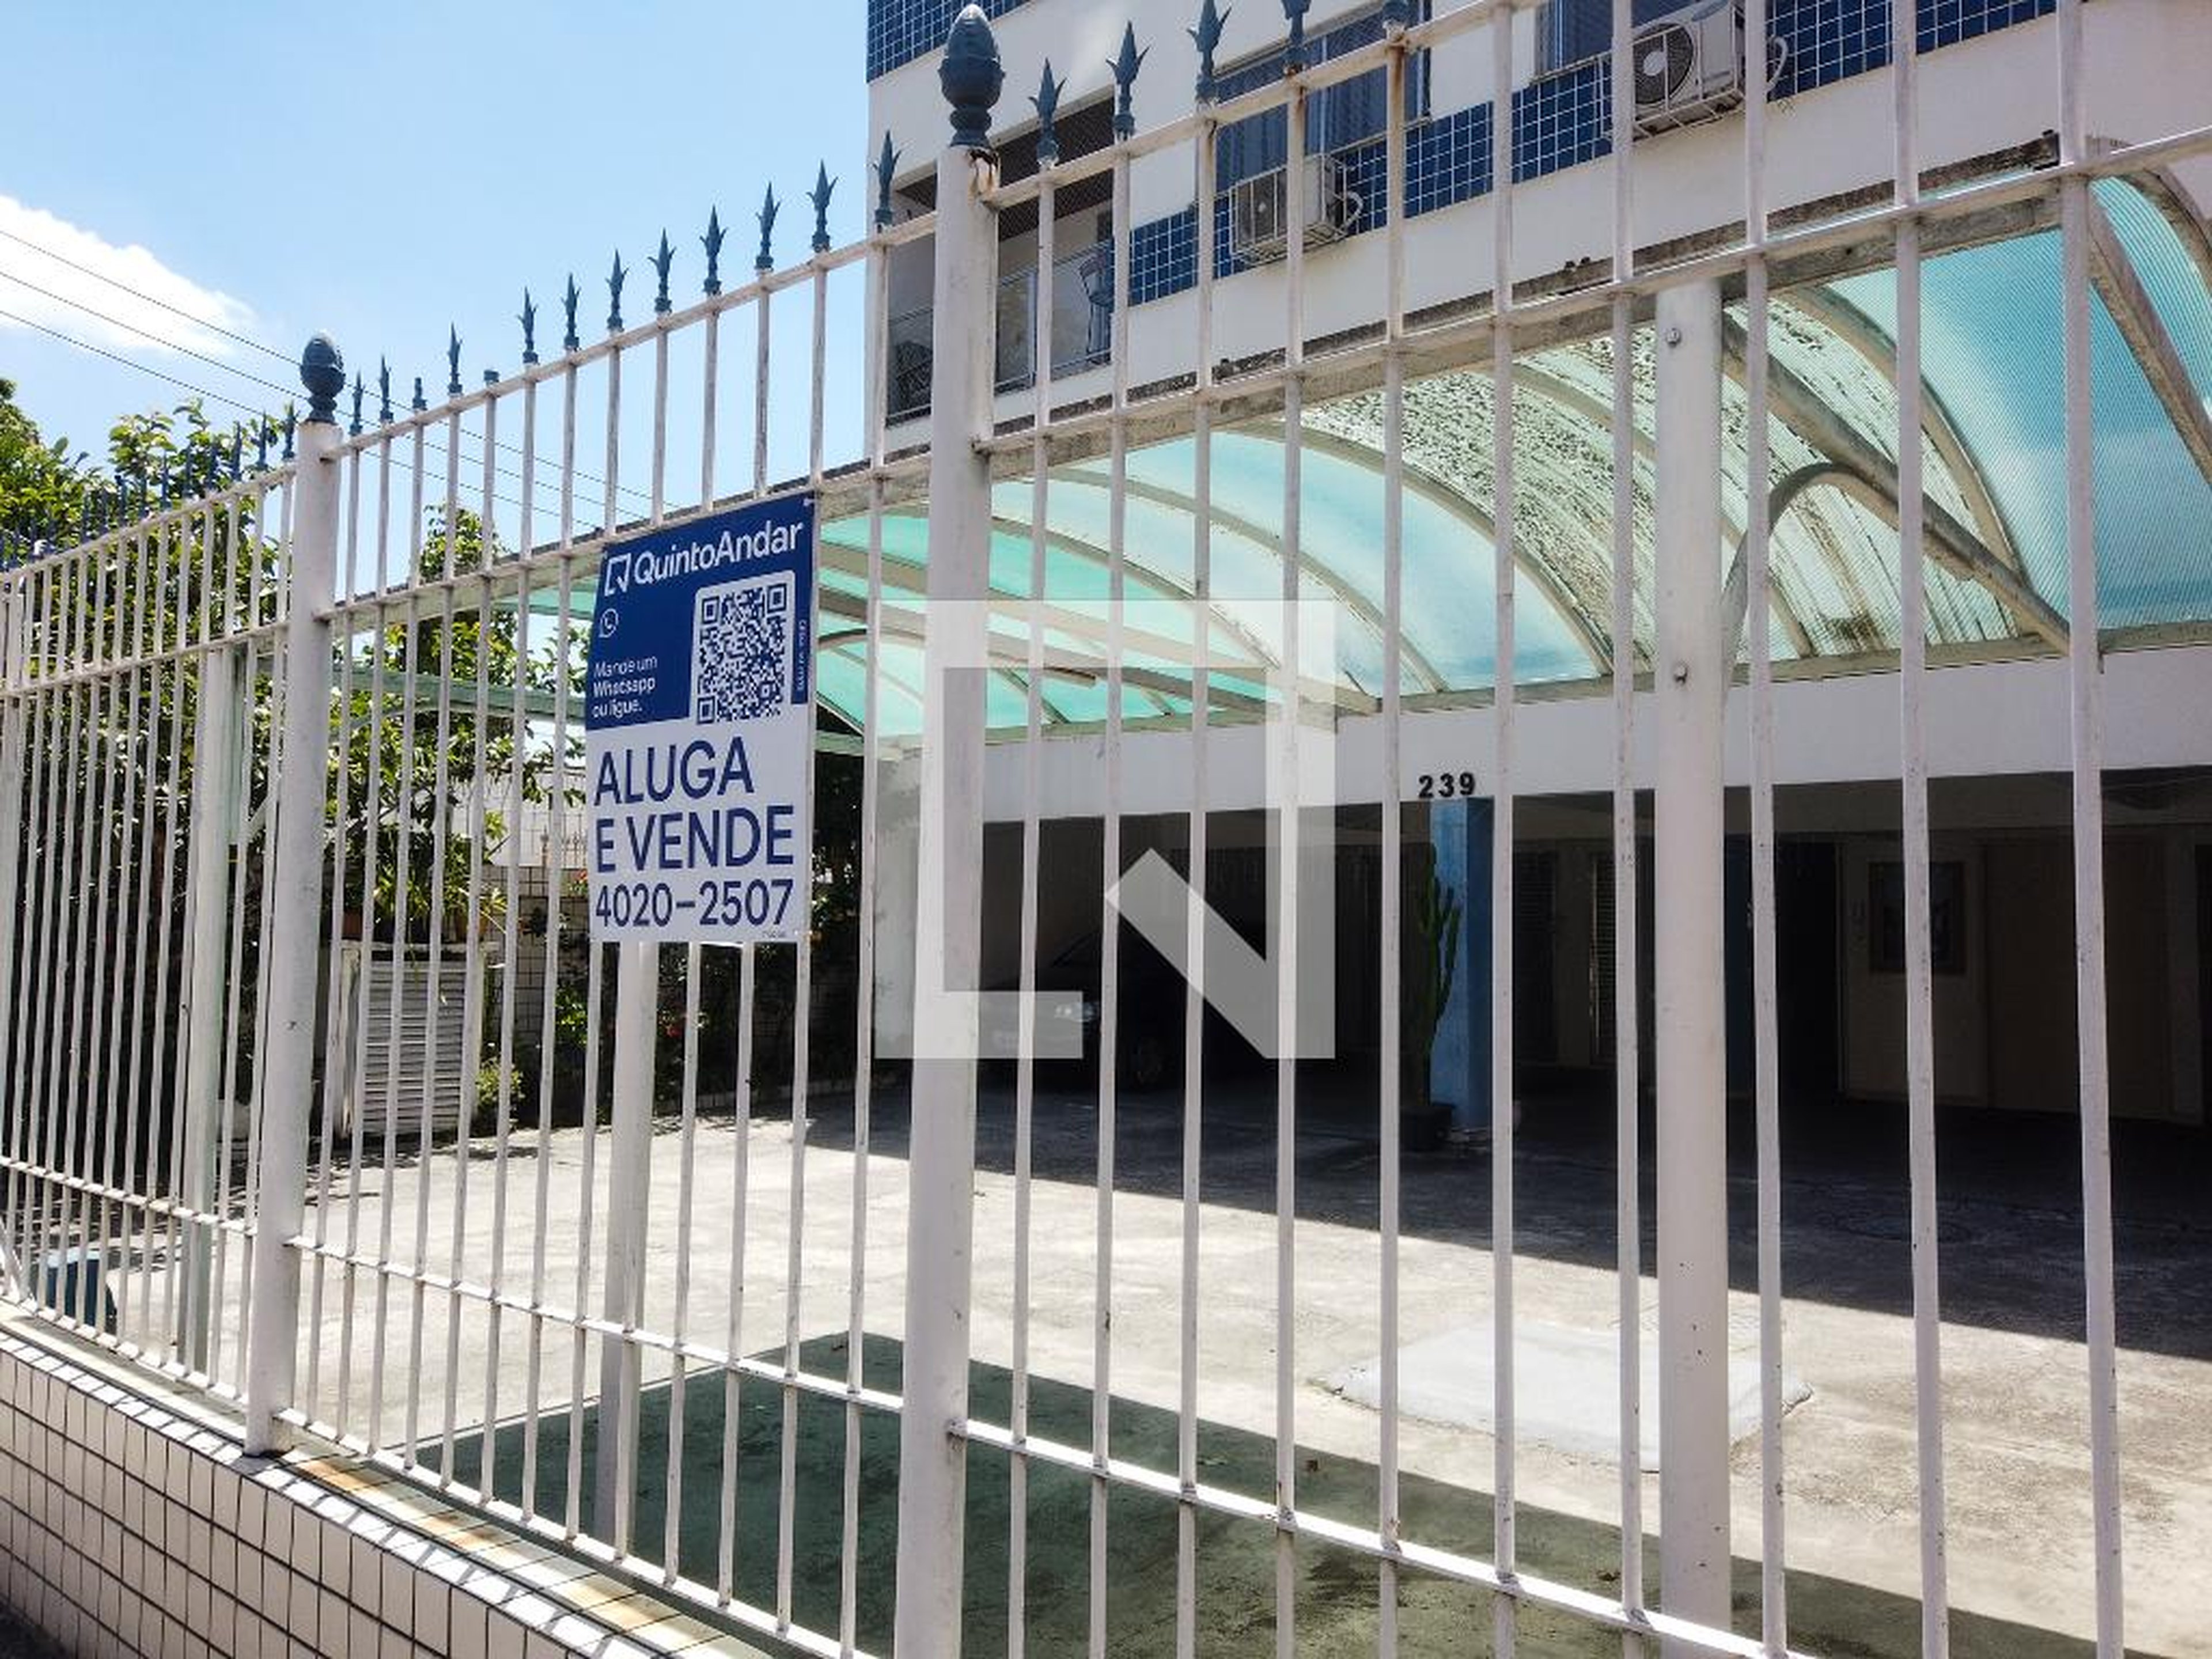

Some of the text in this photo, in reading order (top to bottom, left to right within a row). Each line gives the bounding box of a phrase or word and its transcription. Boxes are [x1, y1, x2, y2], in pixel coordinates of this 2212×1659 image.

[634, 521, 804, 584] QuintoAndar
[637, 656, 657, 672] um
[592, 704, 608, 717] ou
[594, 736, 755, 805] ALUGA
[1418, 772, 1475, 798] 239
[596, 805, 794, 873] E VENDE
[596, 878, 794, 927] 4020-2507
